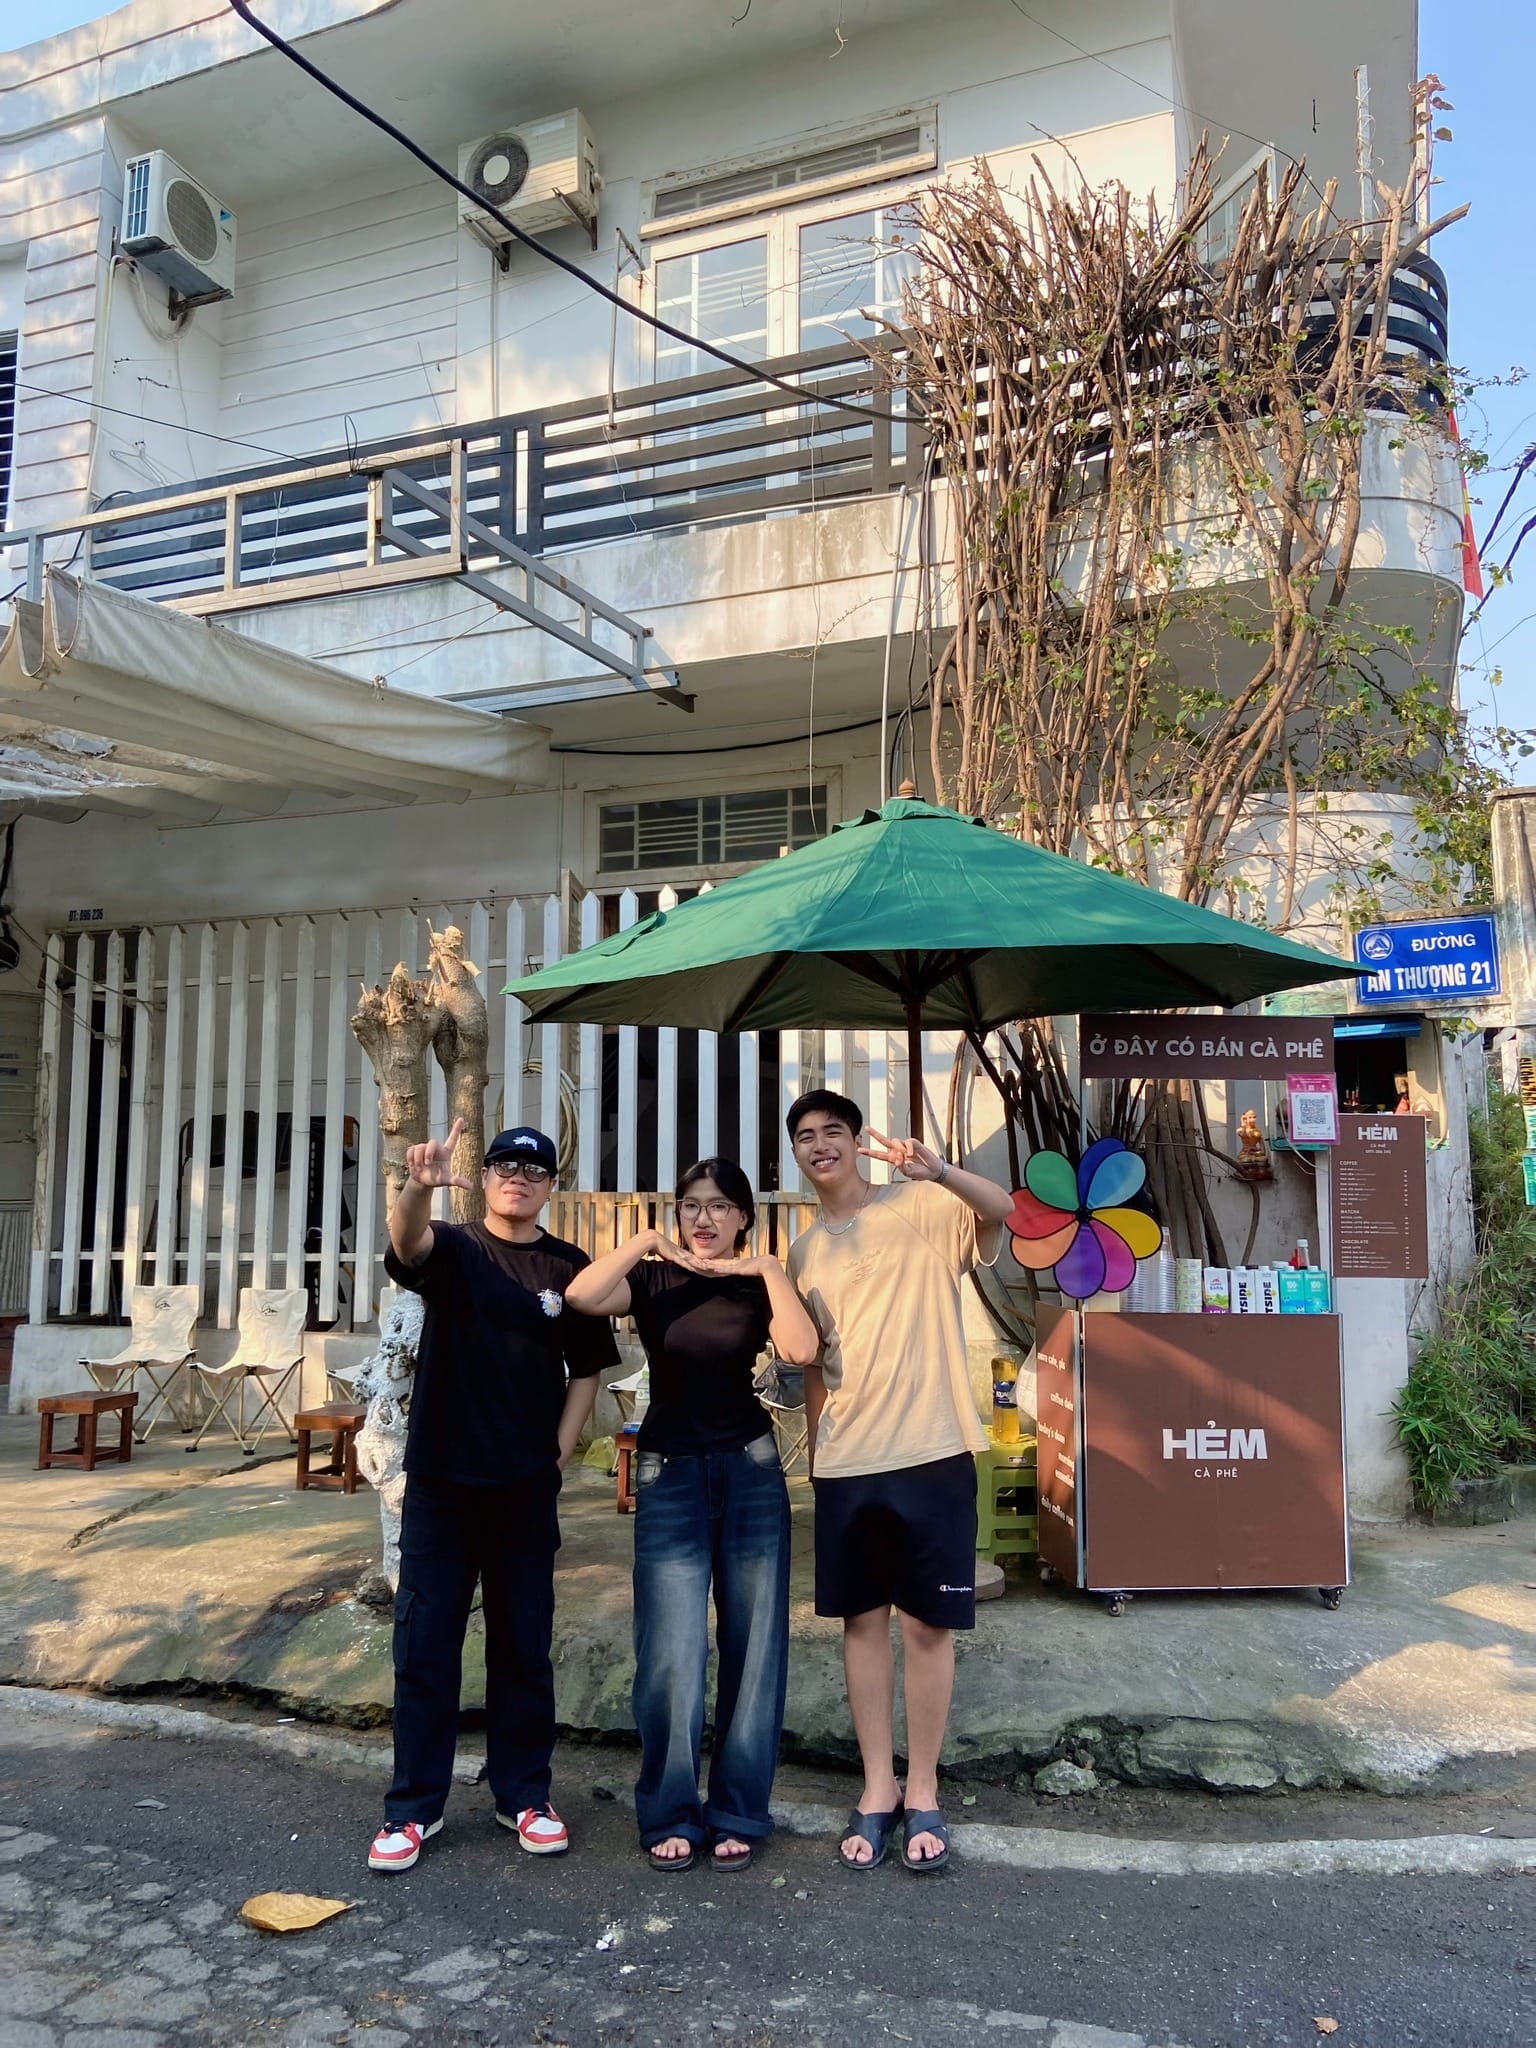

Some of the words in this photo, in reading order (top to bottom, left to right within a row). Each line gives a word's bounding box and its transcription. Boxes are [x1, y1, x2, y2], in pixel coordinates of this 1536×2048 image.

[1411, 931, 1476, 952] ĐƯỜNG
[1367, 968, 1392, 993] AN
[1394, 963, 1467, 993] THƯỢNG
[1470, 961, 1492, 985] 21
[1089, 1034, 1108, 1055] Ở
[1114, 1035, 1159, 1056] ĐÂY
[1165, 1035, 1196, 1056] CÓ
[1201, 1036, 1244, 1057] BÁN
[1250, 1037, 1279, 1058] CÀ
[1286, 1038, 1324, 1058] PHÊ
[1162, 1420, 1268, 1460] HẺM
[1194, 1466, 1211, 1478] CÀ
[1216, 1467, 1239, 1478] PHÊ
